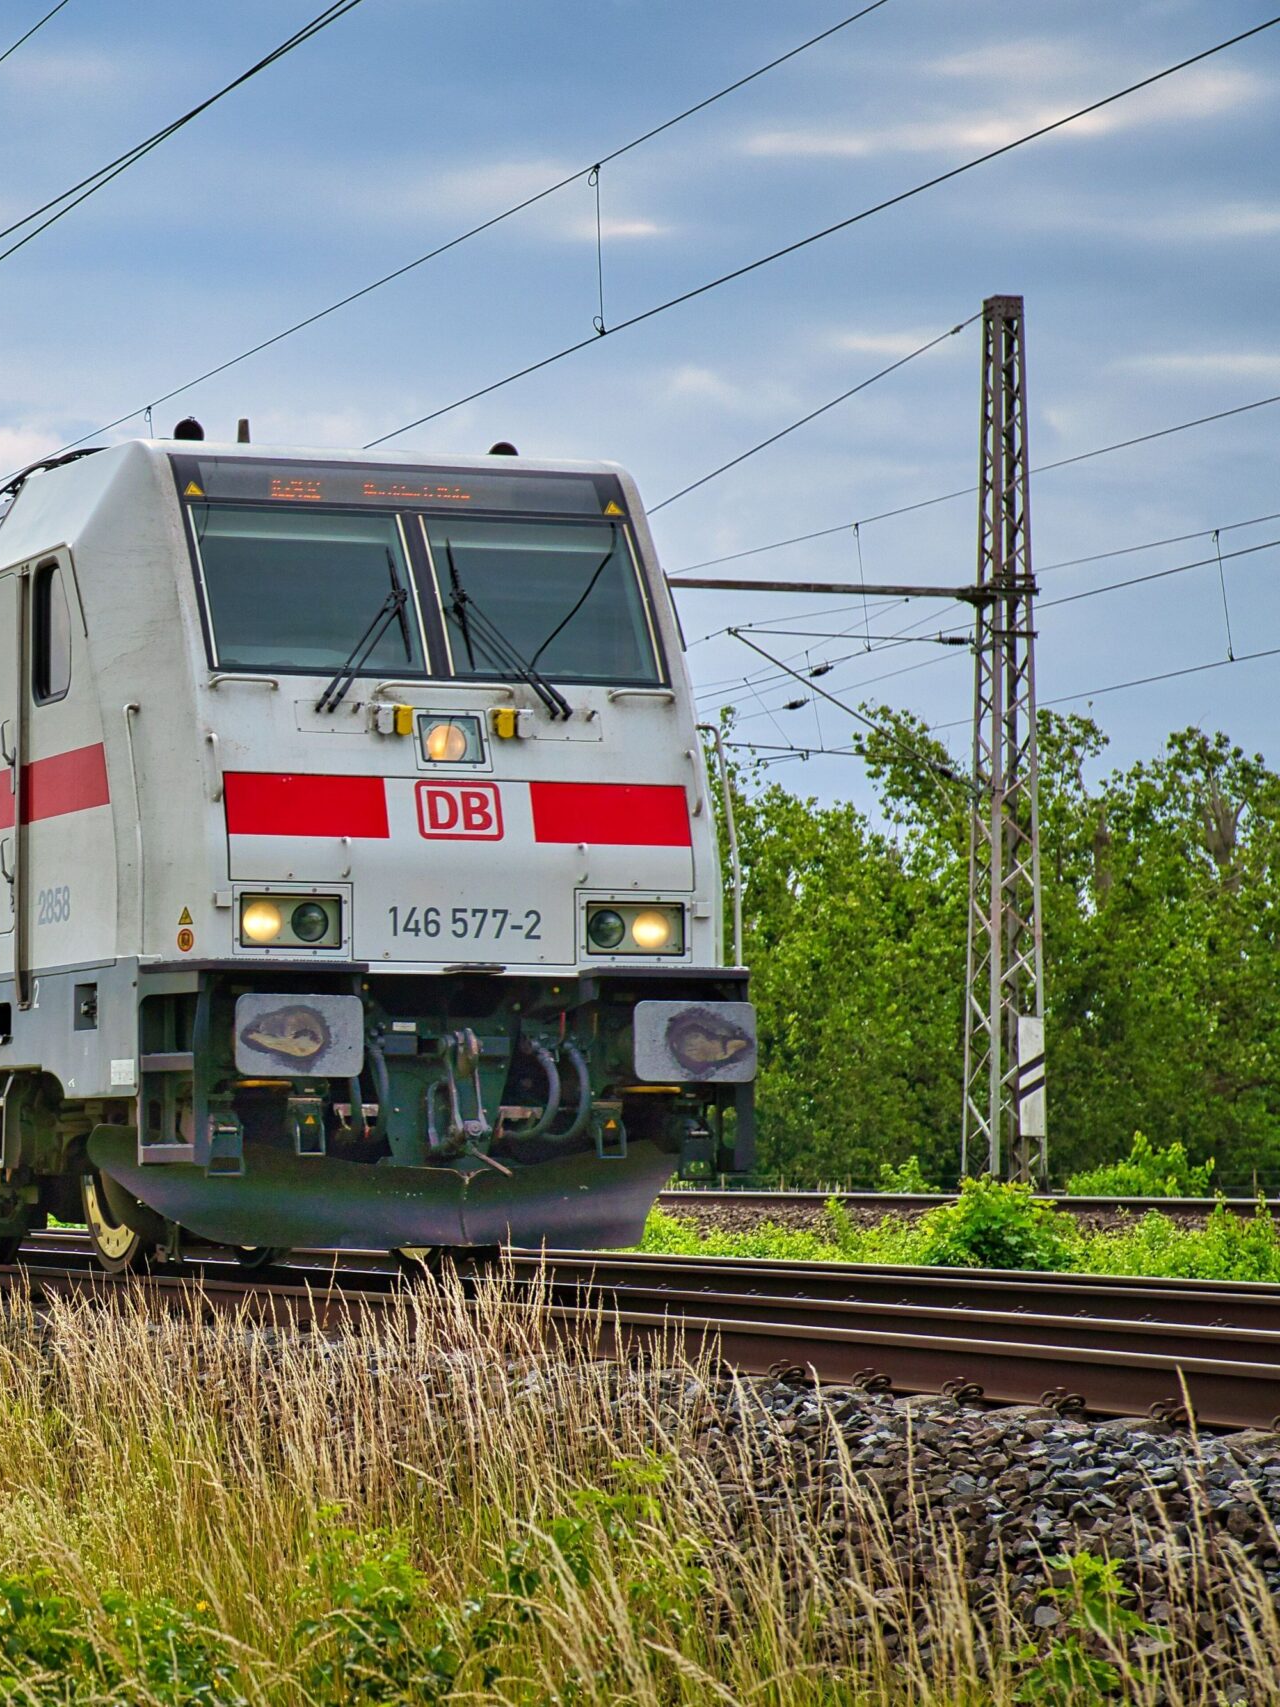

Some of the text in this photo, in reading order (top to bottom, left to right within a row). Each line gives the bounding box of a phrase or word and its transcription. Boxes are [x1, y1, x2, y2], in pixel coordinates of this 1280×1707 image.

[424, 788, 495, 832] DB
[37, 885, 70, 926] 2858
[388, 906, 541, 940] 146 577-2
[33, 979, 40, 1009] 2
